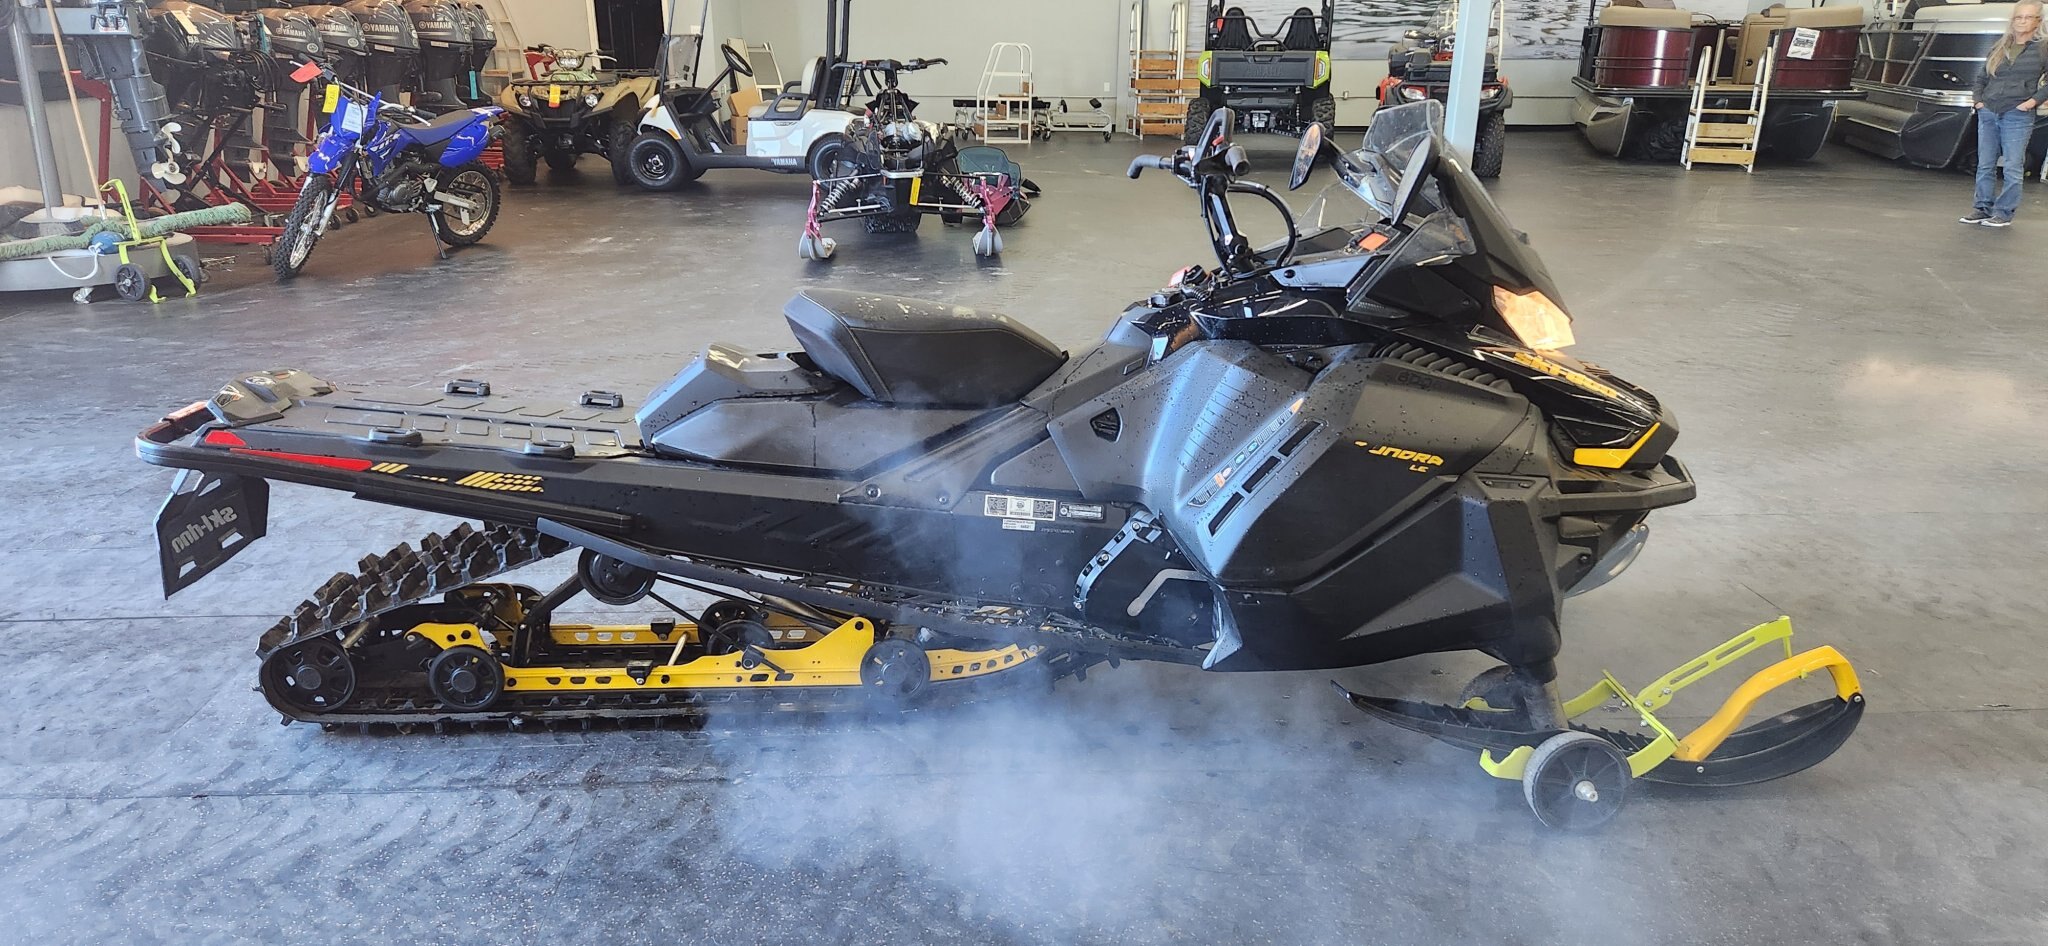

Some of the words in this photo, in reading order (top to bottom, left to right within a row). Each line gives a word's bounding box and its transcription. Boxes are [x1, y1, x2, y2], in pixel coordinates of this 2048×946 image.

[323, 23, 348, 32] YAMAHA
[370, 23, 399, 33] YAMAHA
[426, 21, 452, 29] YAMAHA
[283, 29, 307, 38] YAMAHA
[773, 157, 797, 166] YAMAHA
[1354, 440, 1444, 466] UNDRA
[1409, 464, 1429, 473] LE
